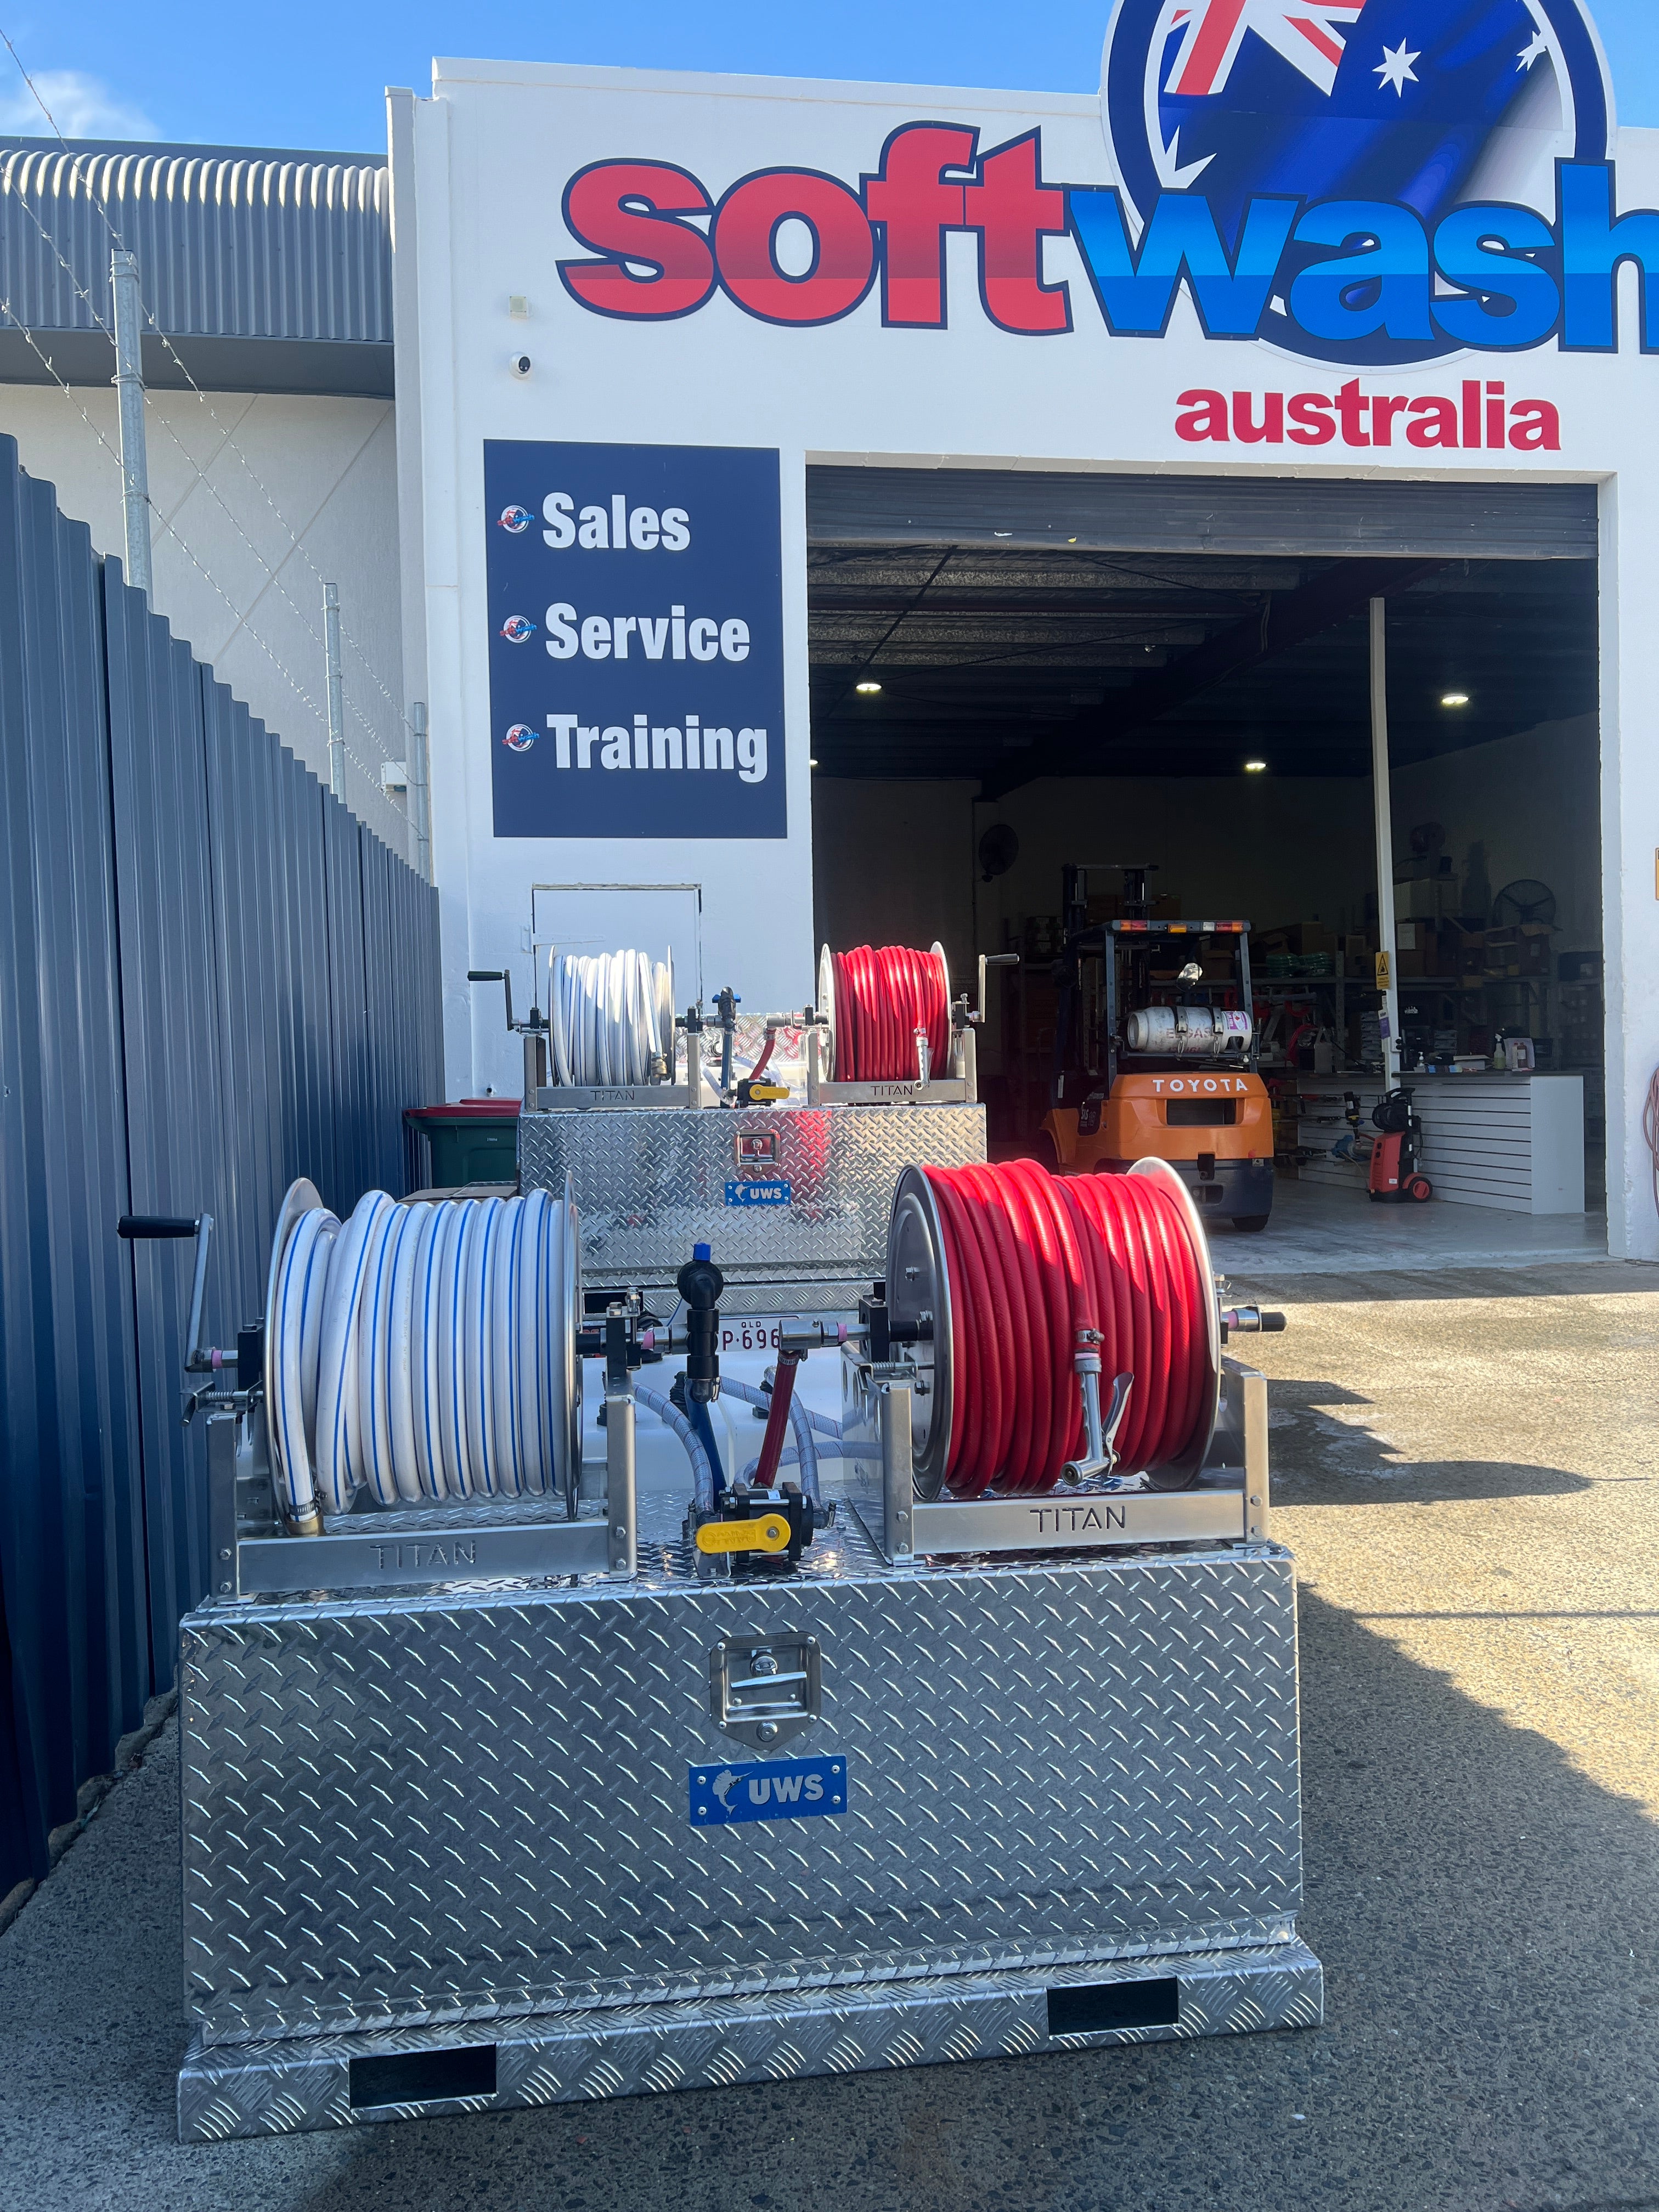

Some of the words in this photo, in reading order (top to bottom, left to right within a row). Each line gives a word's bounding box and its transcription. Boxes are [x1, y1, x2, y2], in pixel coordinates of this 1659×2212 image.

[1174, 377, 1562, 451] australia
[542, 492, 691, 551] Sales
[545, 602, 751, 662] Service
[546, 713, 769, 783] Training
[590, 1090, 635, 1101] TITAN
[870, 1085, 913, 1096] TITAN
[1152, 1078, 1248, 1093] TOYOTA
[749, 1187, 782, 1200] UWS
[1029, 1505, 1125, 1533] TITAN
[369, 1539, 476, 1570] TITAN
[748, 1773, 824, 1805] UWS
